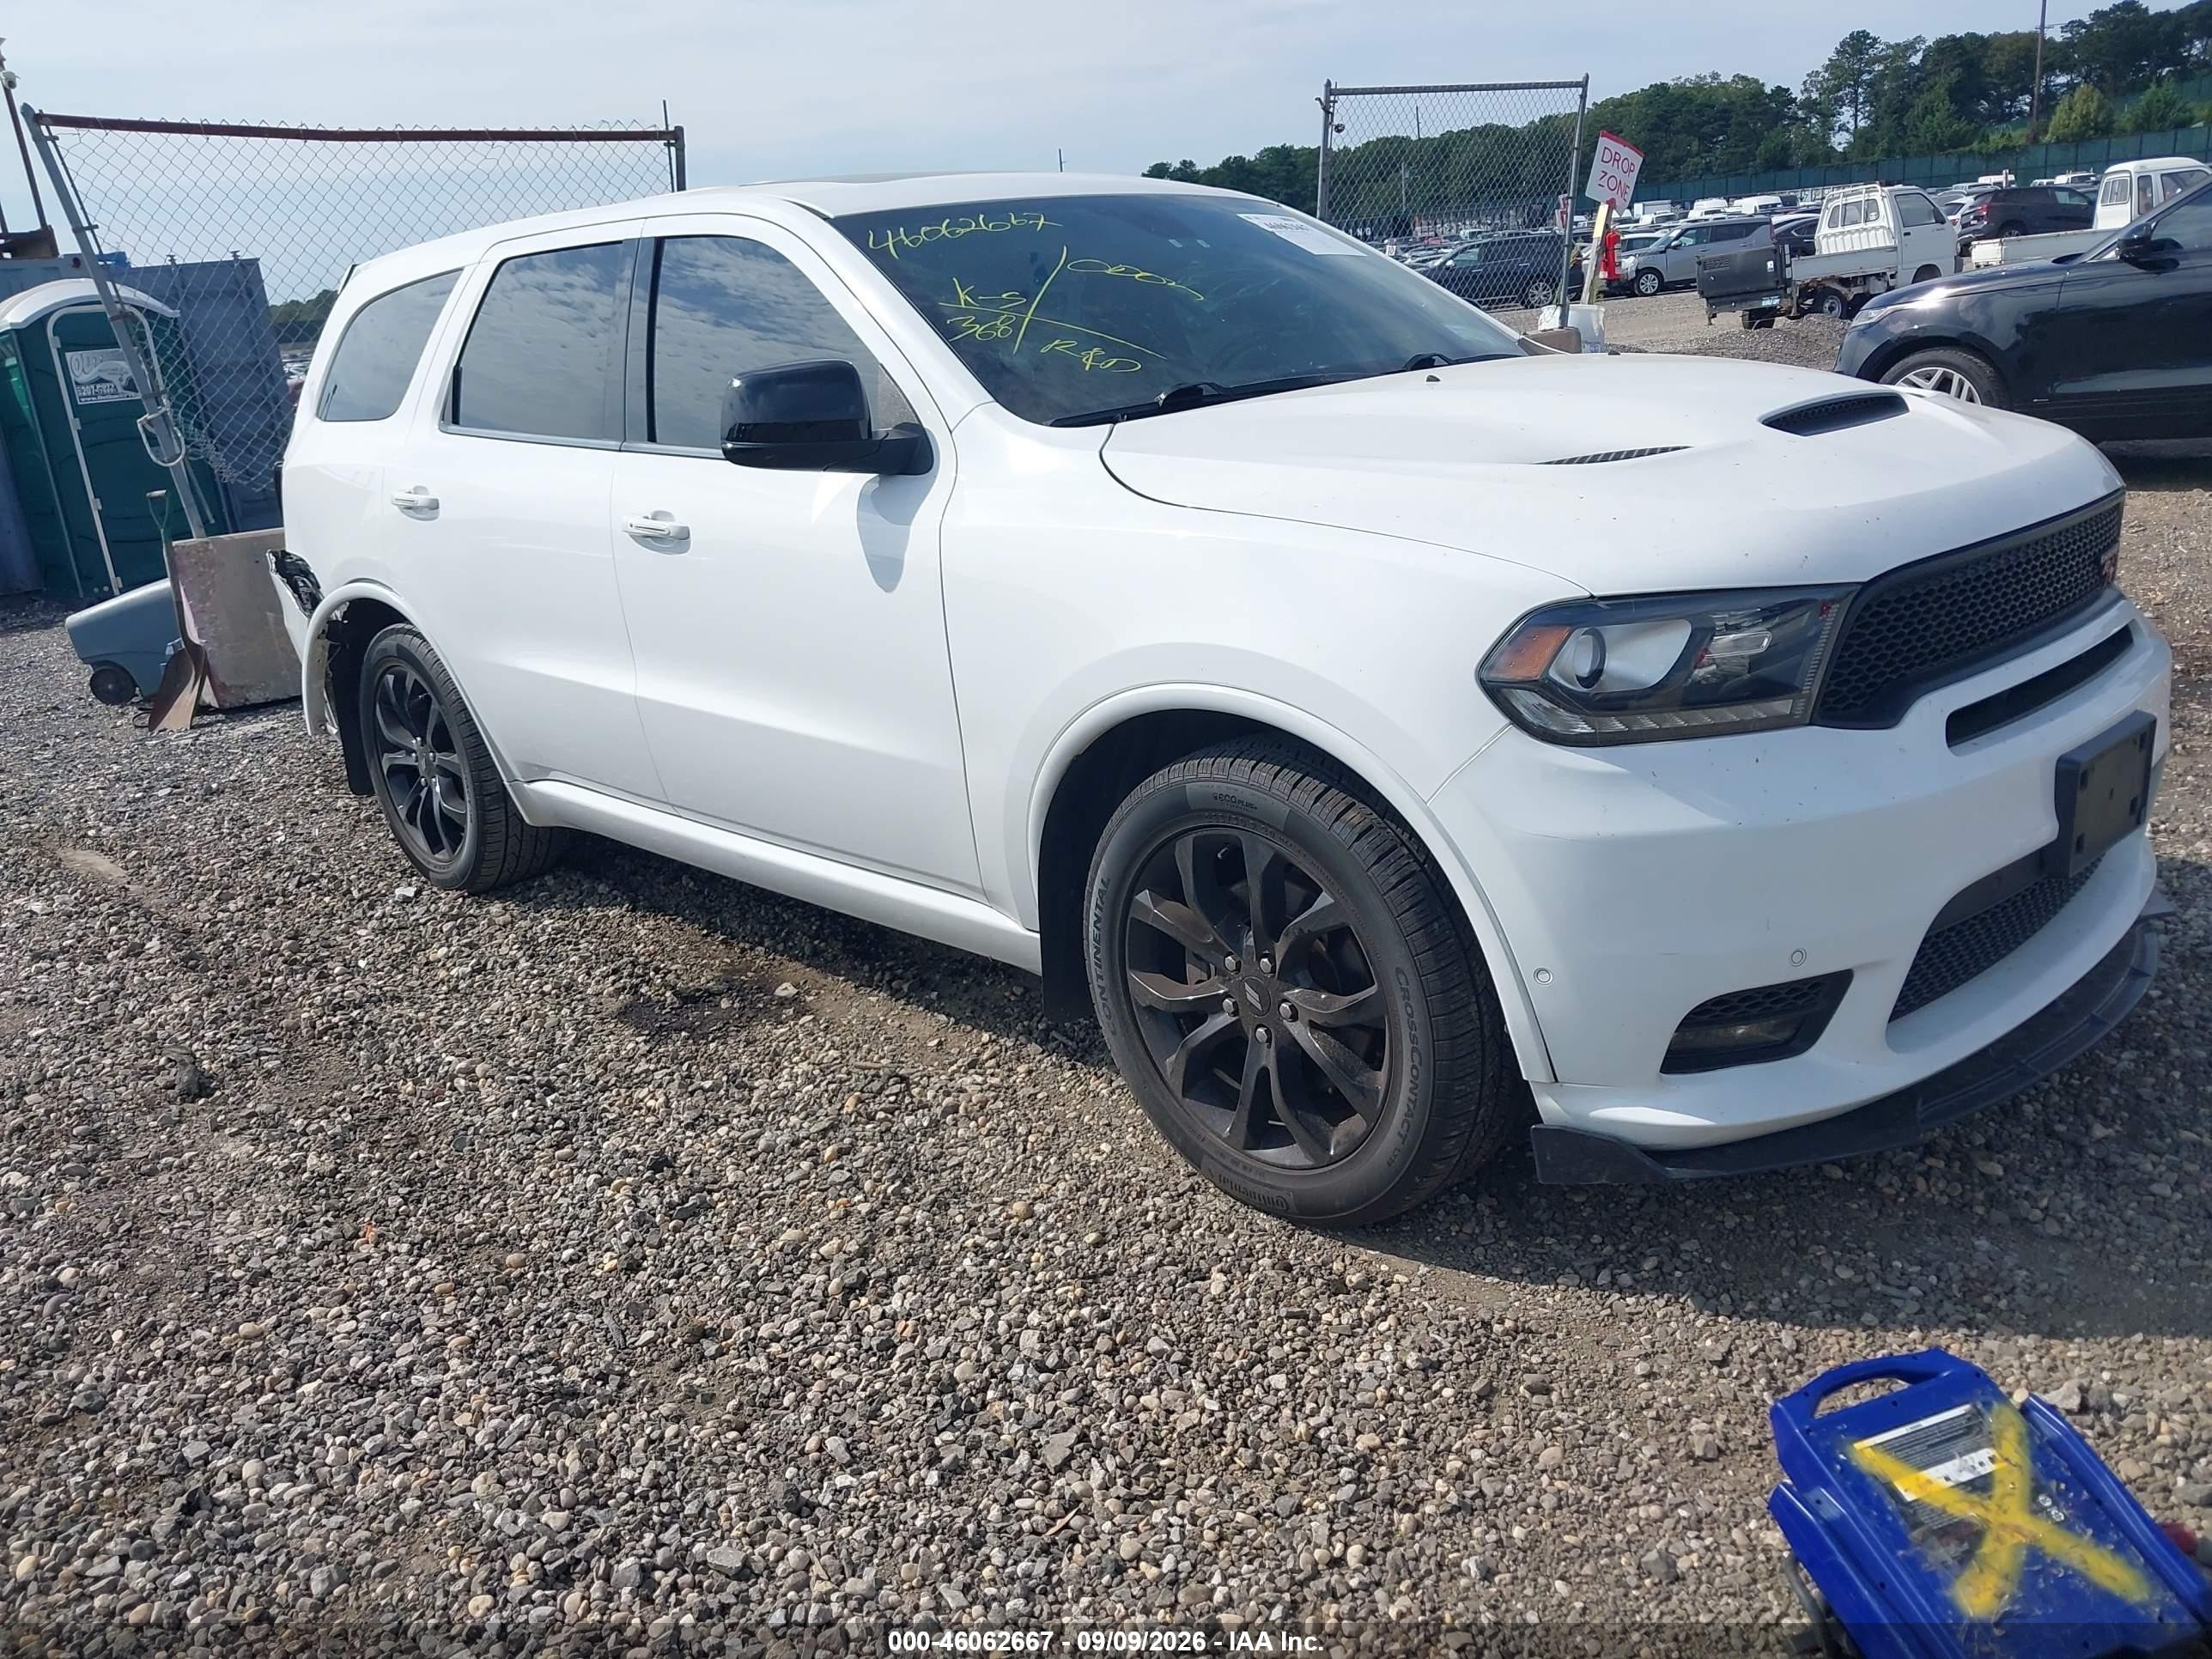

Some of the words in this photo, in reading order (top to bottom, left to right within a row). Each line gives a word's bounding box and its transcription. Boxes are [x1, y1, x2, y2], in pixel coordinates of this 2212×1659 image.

[1601, 146, 1636, 178] DROP
[1598, 170, 1631, 202] ZONE
[868, 213, 1063, 259] 46062667
[1091, 878, 1116, 1036] CONTINENTAL
[1395, 966, 1423, 1146] CROSSCONTACT
